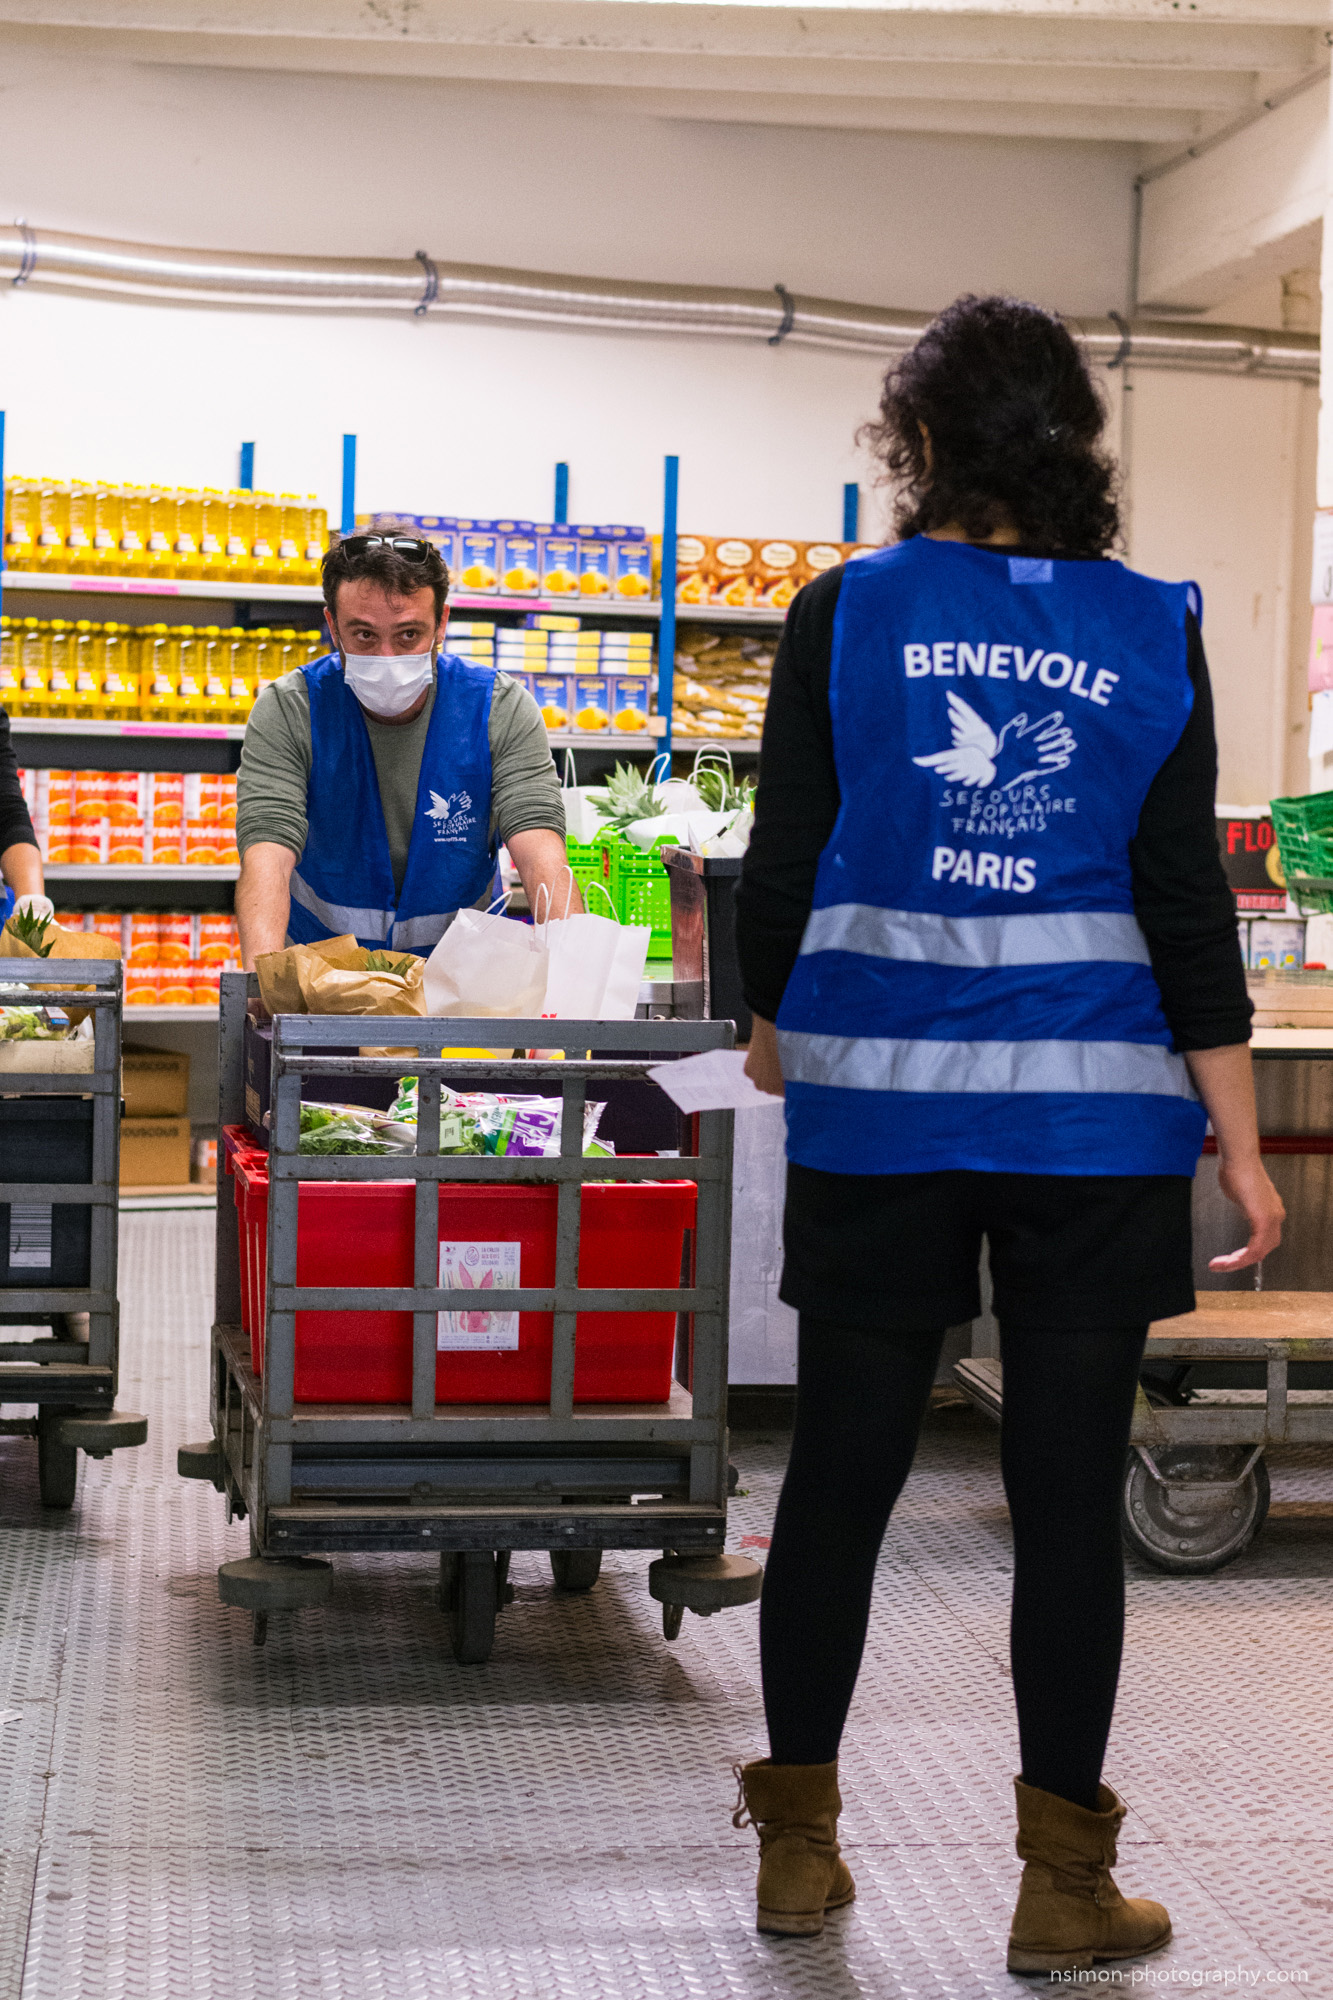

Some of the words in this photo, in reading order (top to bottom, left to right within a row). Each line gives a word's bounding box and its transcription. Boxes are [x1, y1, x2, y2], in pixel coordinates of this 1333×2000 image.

[903, 641, 1120, 707] BENEVOLE
[939, 784, 1051, 807] SECOURS
[969, 797, 1077, 820] POPULAIRE
[433, 814, 468, 828] SECOURS
[950, 815, 1048, 839] FRANÇAIS
[1226, 821, 1276, 855] FLO
[931, 846, 1037, 894] PARIS
